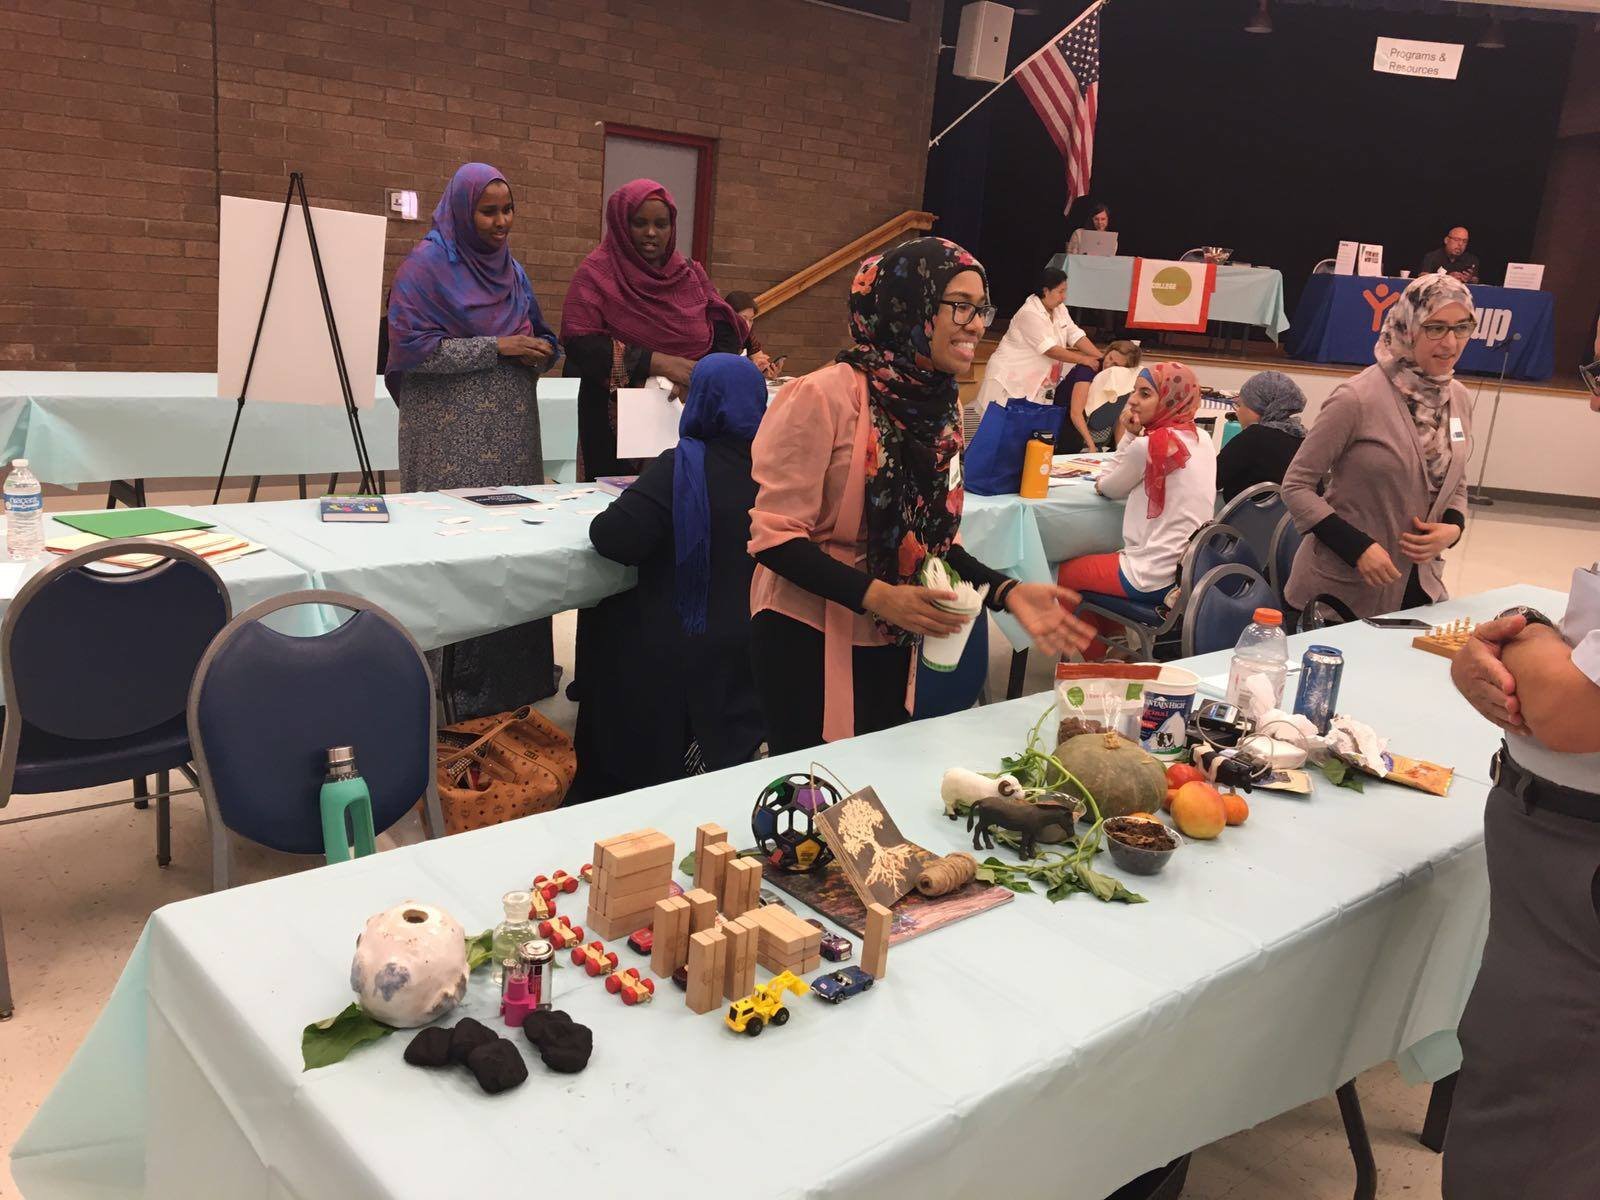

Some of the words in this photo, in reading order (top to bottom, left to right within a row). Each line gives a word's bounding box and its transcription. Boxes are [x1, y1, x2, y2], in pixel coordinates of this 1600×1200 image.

[1390, 48, 1436, 61] Programs
[1439, 53, 1447, 62] &
[1389, 62, 1439, 75] Resources
